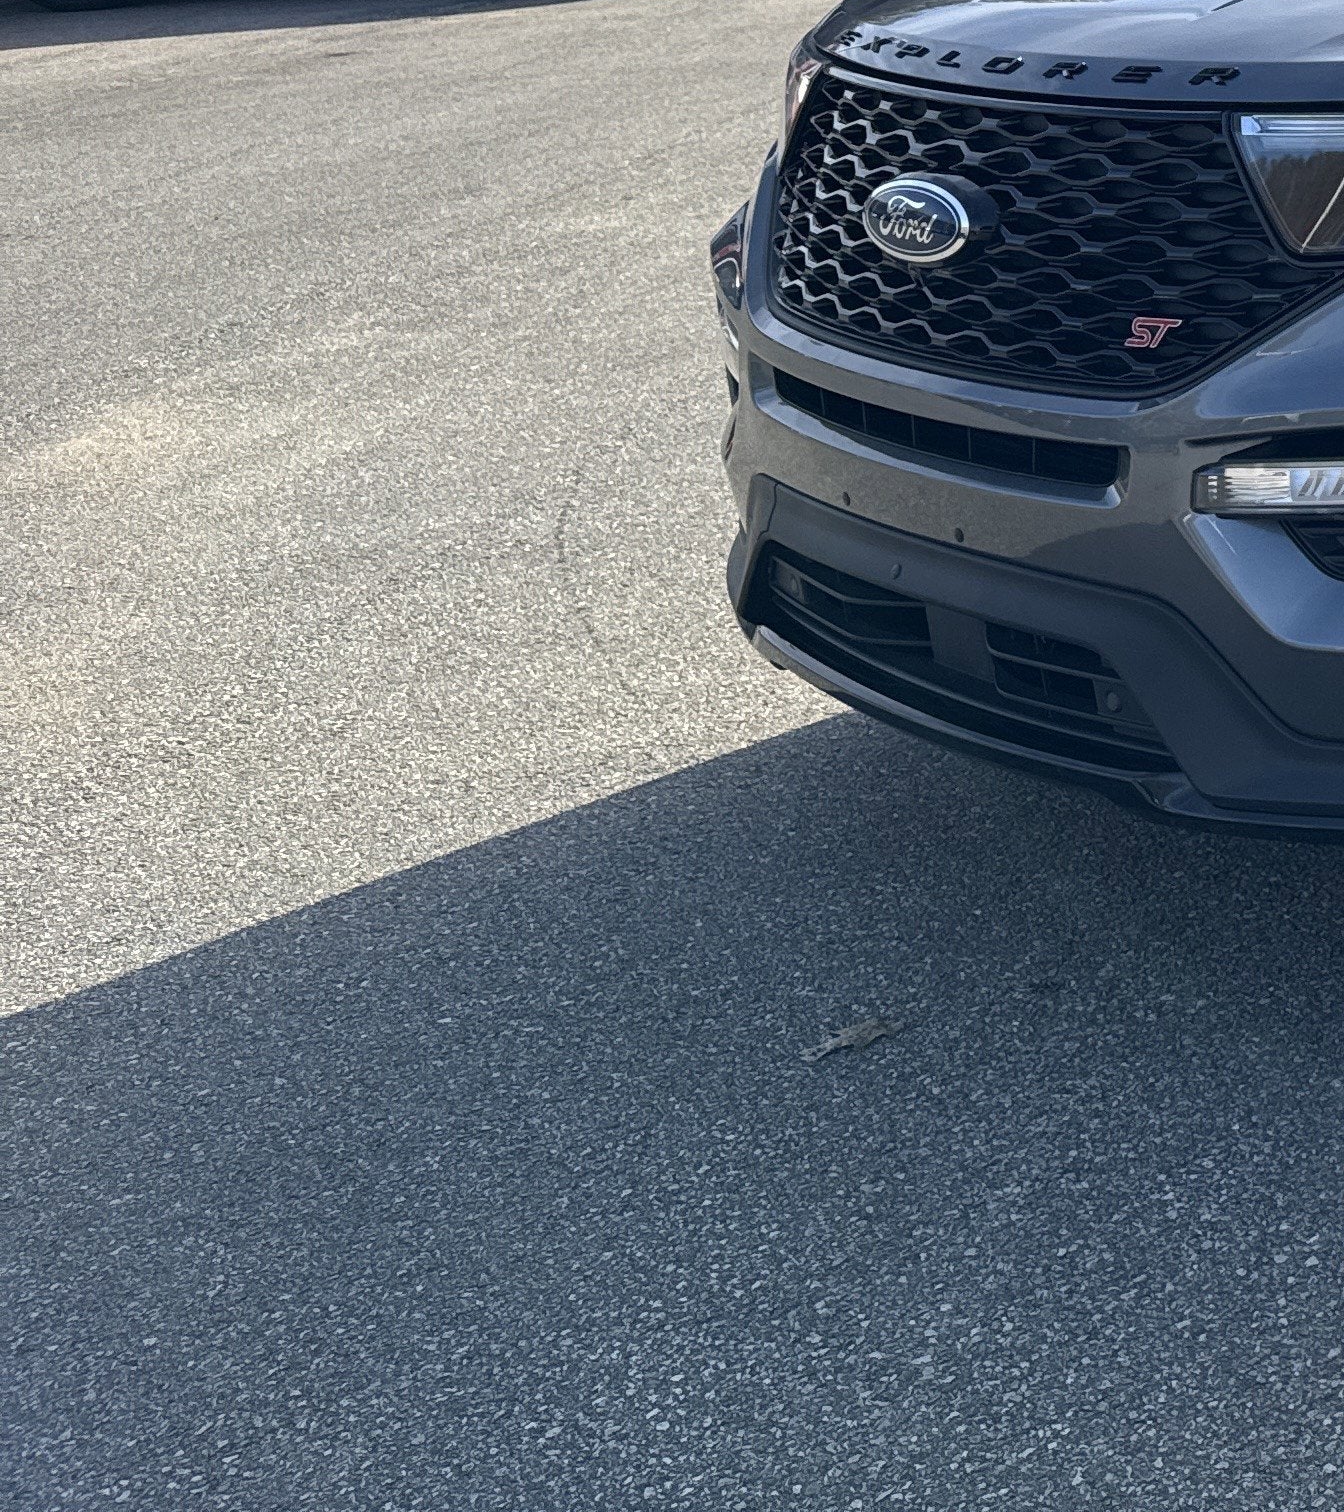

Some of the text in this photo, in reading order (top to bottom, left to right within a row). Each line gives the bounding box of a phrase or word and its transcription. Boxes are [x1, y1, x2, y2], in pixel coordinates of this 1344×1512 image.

[837, 29, 1241, 87] EXPLORER
[879, 194, 939, 244] Ford
[1124, 317, 1183, 349] ST
